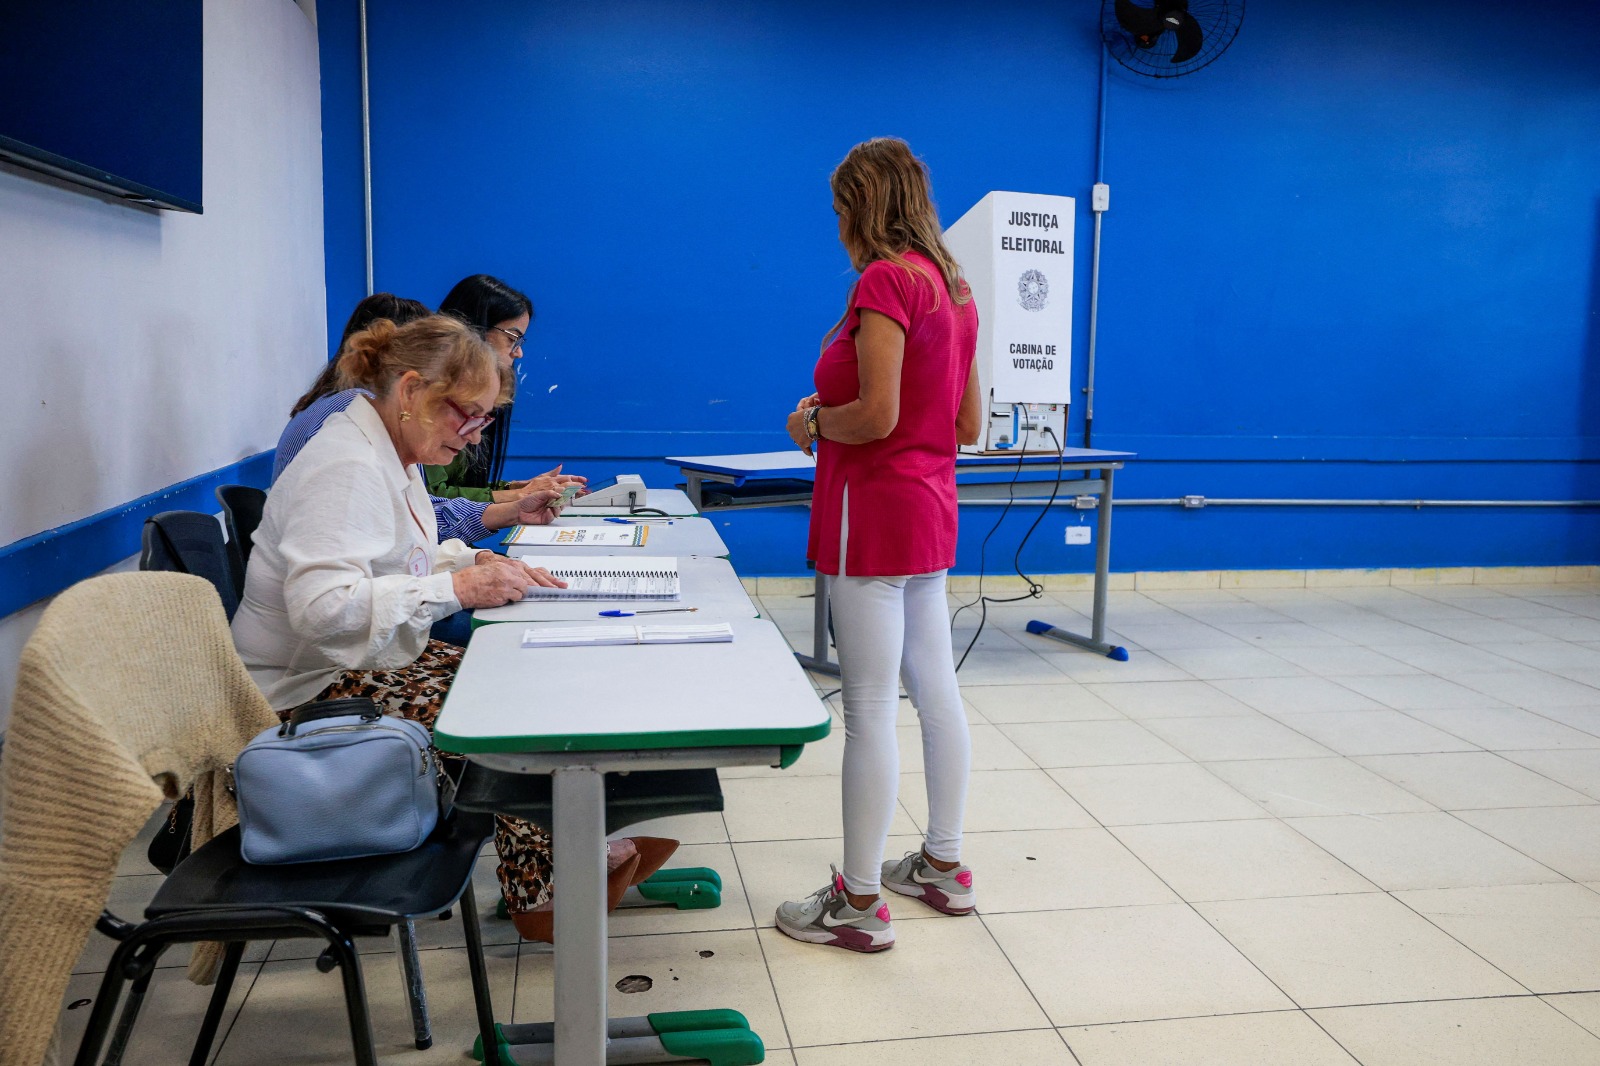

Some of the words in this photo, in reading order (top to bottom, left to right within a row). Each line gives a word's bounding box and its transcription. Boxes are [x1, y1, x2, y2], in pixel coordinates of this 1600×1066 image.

[1008, 211, 1059, 232] JUSTIÇA
[1001, 236, 1065, 254] ELEITORAL
[1009, 343, 1043, 355] CABINA
[1045, 344, 1057, 356] DE
[1012, 356, 1054, 372] VOTAÇÃO
